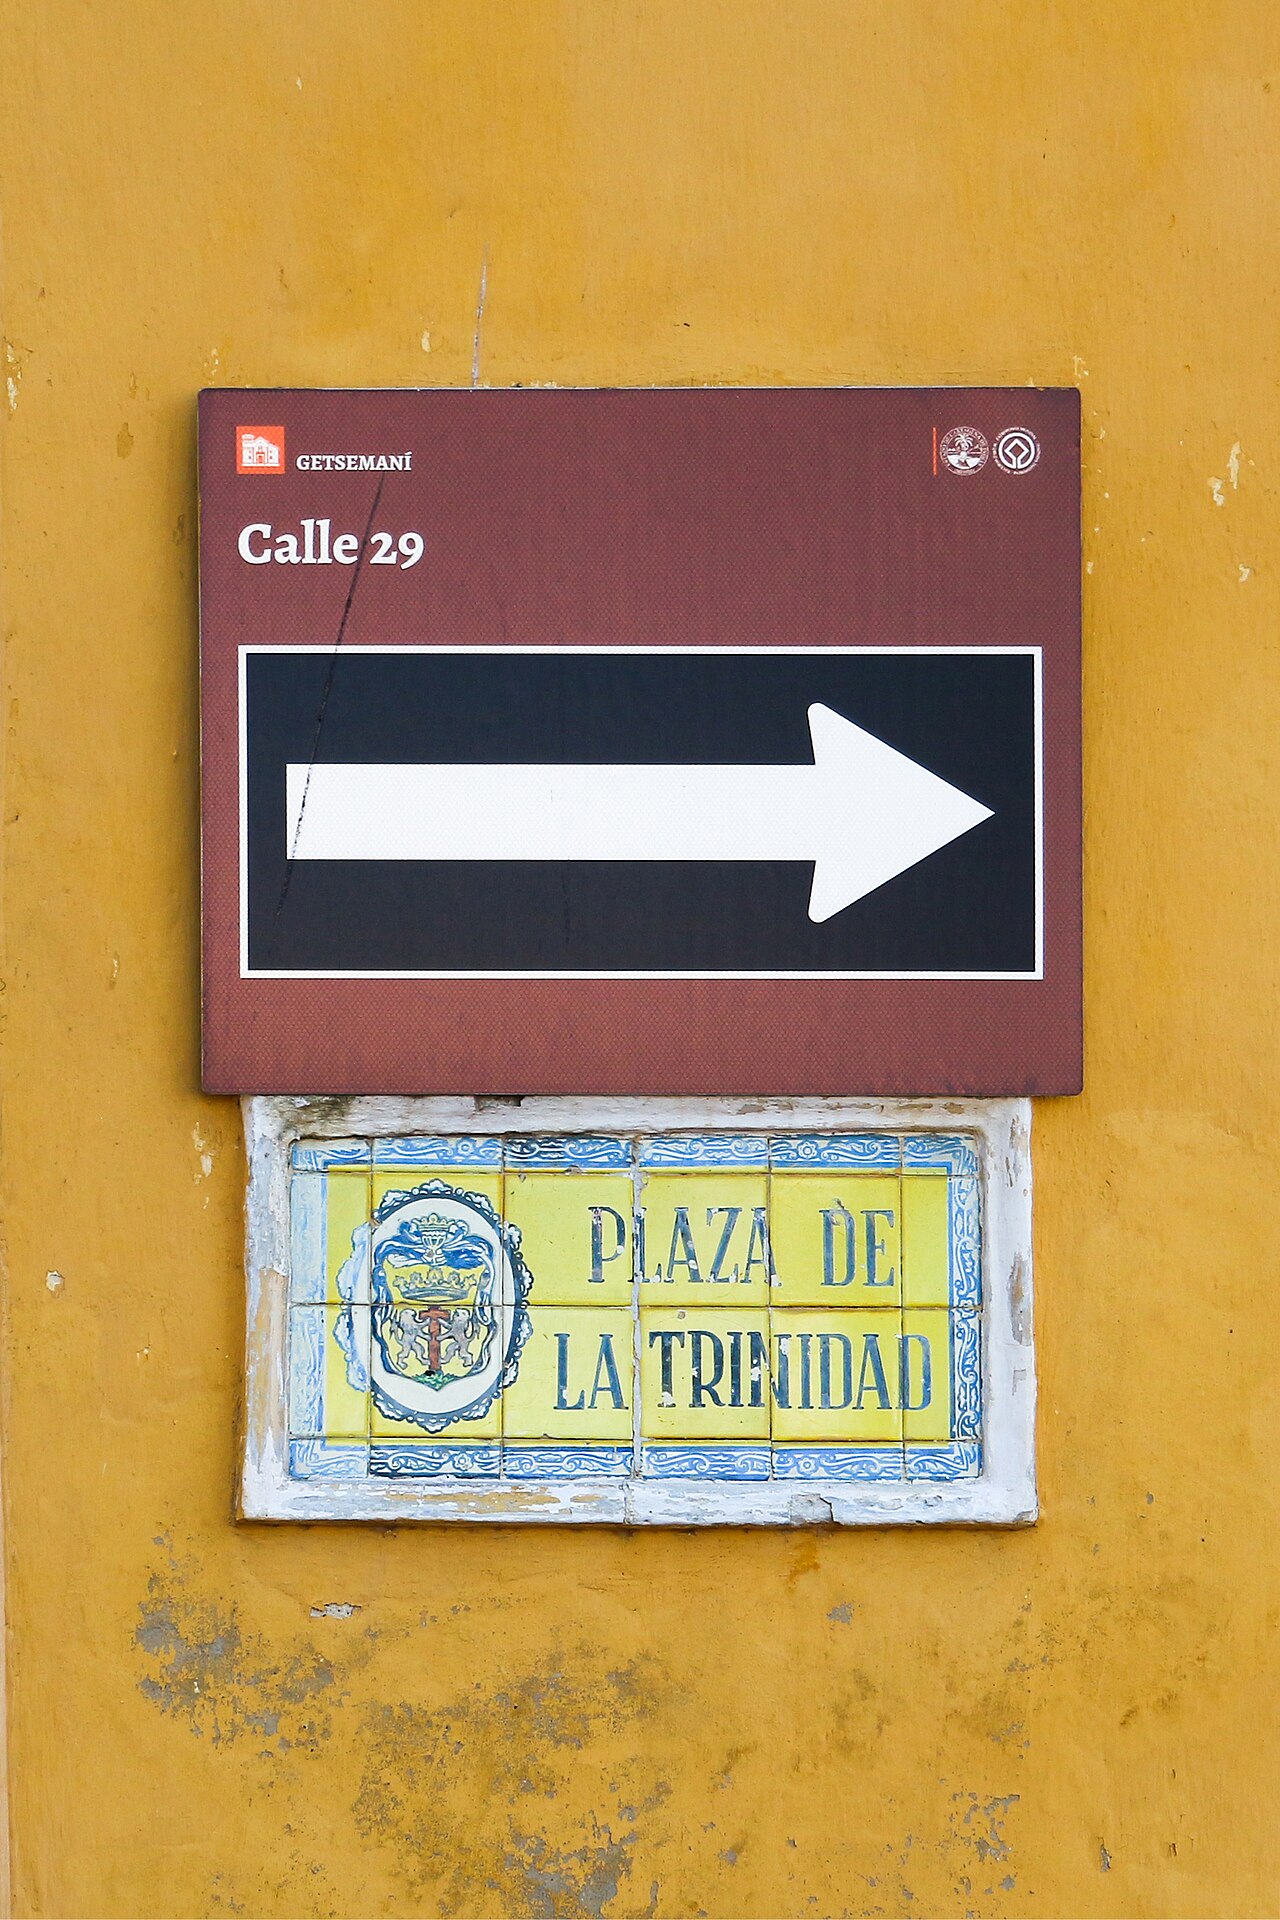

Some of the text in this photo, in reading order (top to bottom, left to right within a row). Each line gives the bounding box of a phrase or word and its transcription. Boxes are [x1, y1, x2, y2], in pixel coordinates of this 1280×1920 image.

[296, 451, 412, 471] GETSEMANÍ
[238, 519, 425, 569] Calle 29
[588, 1207, 895, 1286] PLAZA DE
[553, 1332, 932, 1410] LA TRINIDAD
